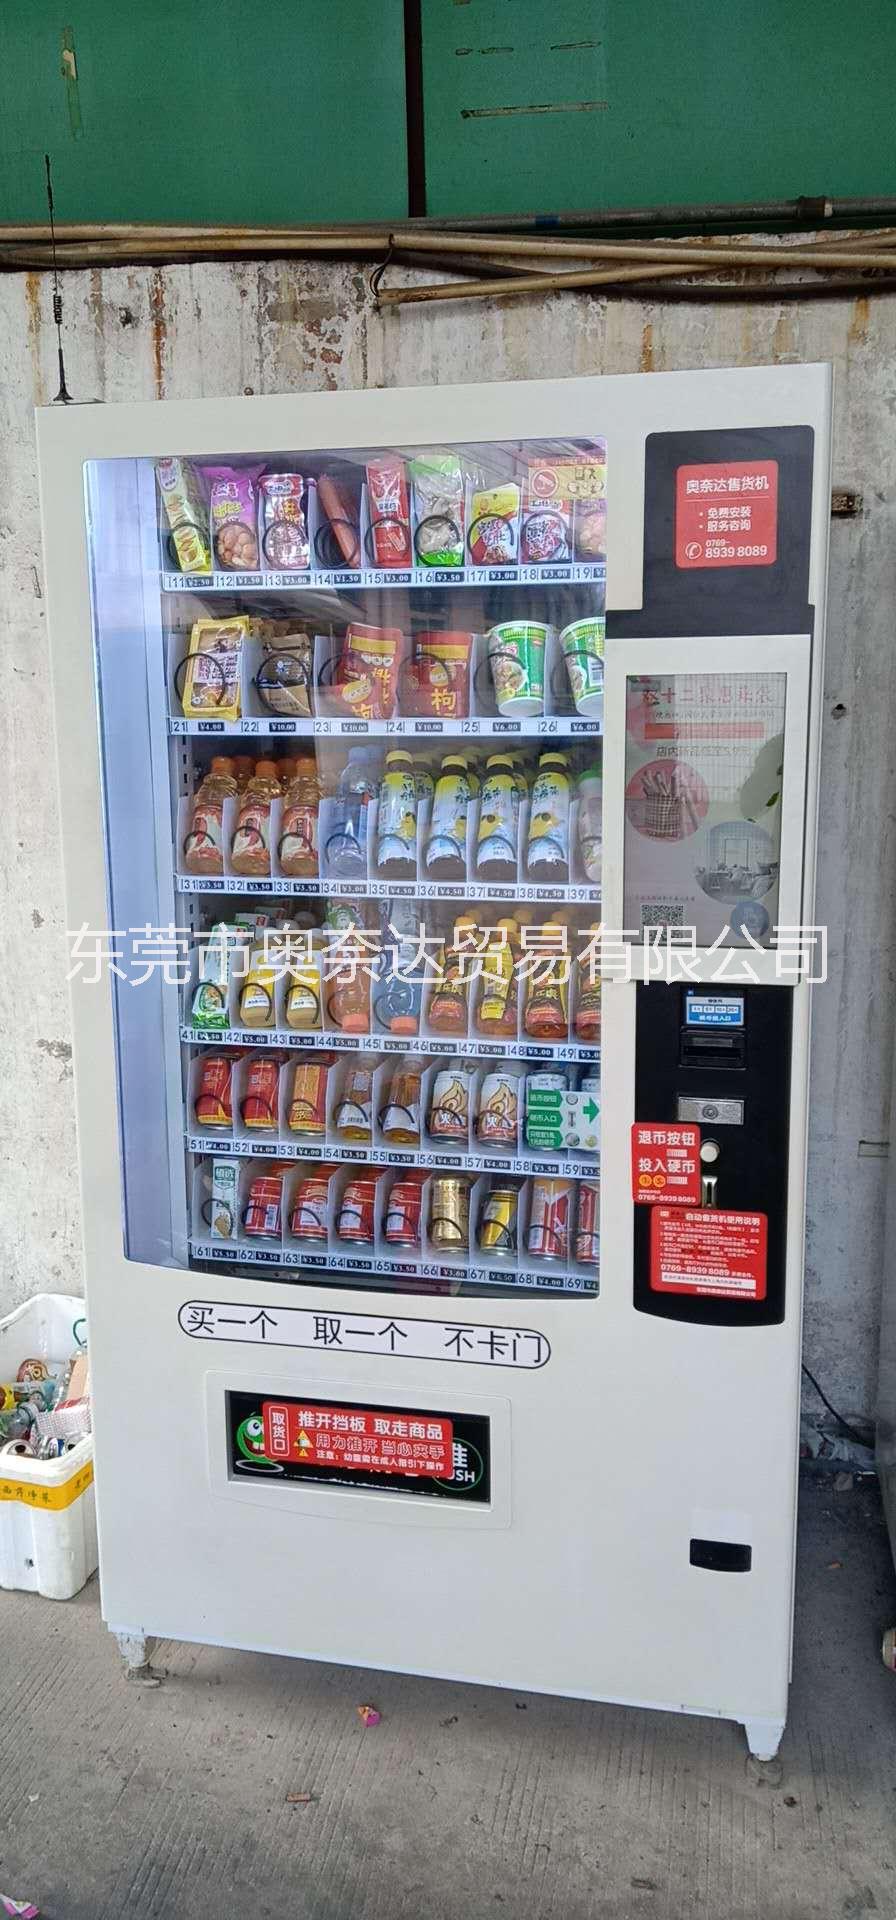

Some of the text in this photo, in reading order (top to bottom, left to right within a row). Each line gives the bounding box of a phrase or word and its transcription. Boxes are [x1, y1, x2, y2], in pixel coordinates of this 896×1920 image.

[686, 476, 769, 495] 奥奈达售货机
[708, 506, 751, 520] 免费安装
[707, 519, 751, 532] 服务咨询
[705, 545, 768, 558] 8939 8089
[173, 577, 185, 588] 11
[220, 576, 233, 587] 12
[269, 576, 282, 586] 13
[318, 575, 331, 585] 14
[368, 573, 380, 584] 15
[418, 572, 431, 583] 16
[470, 571, 483, 582] 17
[523, 570, 536, 580] 18
[576, 568, 588, 579] 19
[173, 722, 185, 732] 21
[243, 722, 256, 732] 22
[316, 722, 329, 732] 23
[389, 722, 403, 732] 24
[464, 722, 478, 732] 25
[541, 722, 555, 732] 26
[184, 880, 196, 890] 31
[230, 881, 243, 891] 32
[276, 882, 289, 892] 33
[323, 882, 336, 893] 34
[371, 884, 385, 895] 35
[419, 886, 433, 896] 36
[469, 887, 483, 897] 37
[519, 888, 533, 898] 38
[571, 890, 584, 900] 39
[227, 1032, 240, 1042] 42
[272, 1034, 285, 1044] 43
[319, 1036, 332, 1046] 44
[366, 1037, 379, 1048] 45
[413, 1041, 427, 1051] 46
[461, 1043, 475, 1053] 47
[510, 1045, 524, 1056] 48
[560, 1047, 574, 1058] 49
[638, 1131, 696, 1146] 退币按钮
[191, 1139, 203, 1150] 51
[235, 1142, 248, 1152] 52
[280, 1145, 293, 1155] 53
[326, 1148, 339, 1158] 54
[373, 1151, 387, 1161] 55
[419, 1153, 433, 1164] 56
[467, 1156, 481, 1167] 57
[515, 1160, 530, 1170] 58
[565, 1164, 579, 1174] 59
[638, 1158, 695, 1173] 投入硬币
[197, 1247, 209, 1257] 61
[240, 1250, 253, 1260] 62
[285, 1253, 298, 1263] 63
[331, 1257, 344, 1267] 64
[377, 1260, 390, 1271] 65
[423, 1265, 437, 1275] 66
[469, 1268, 483, 1279] 67
[518, 1272, 532, 1283] 68
[567, 1277, 581, 1288] 69
[187, 1306, 541, 1364] 买一个 取一个 不卡门
[271, 1412, 286, 1450] 取货口
[297, 1411, 443, 1440] 推开挡板 取走商品
[316, 1433, 445, 1459] 用力推开 当心夹手
